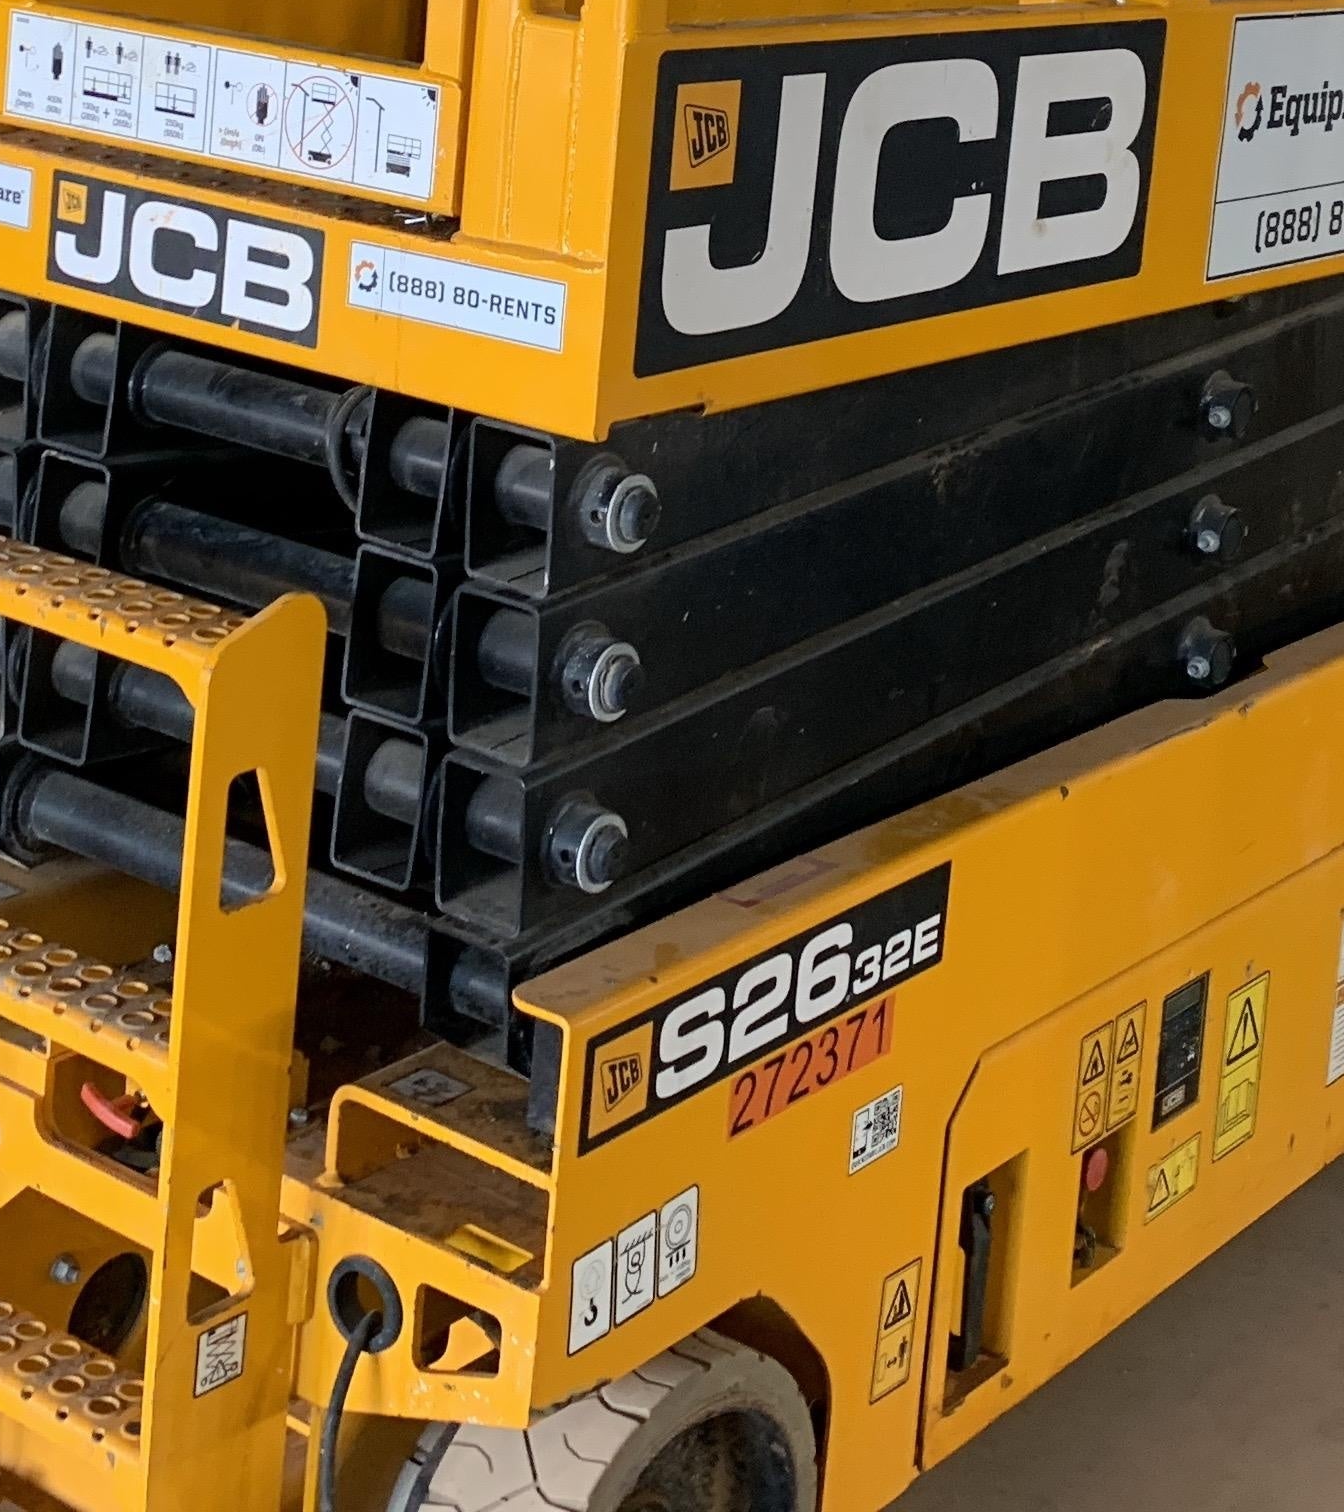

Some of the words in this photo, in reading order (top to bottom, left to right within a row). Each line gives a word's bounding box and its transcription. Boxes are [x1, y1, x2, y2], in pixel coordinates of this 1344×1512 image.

[690, 105, 730, 163] JCB
[660, 48, 1147, 337] JCB
[1255, 201, 1321, 253] (888)
[54, 189, 315, 334] JCB
[389, 271, 445, 302] (888)
[453, 287, 556, 325] 80-RENTS
[656, 922, 853, 1099] S26
[852, 913, 941, 995] 32E
[607, 1055, 643, 1108] JCB
[730, 998, 888, 1137] 272371
